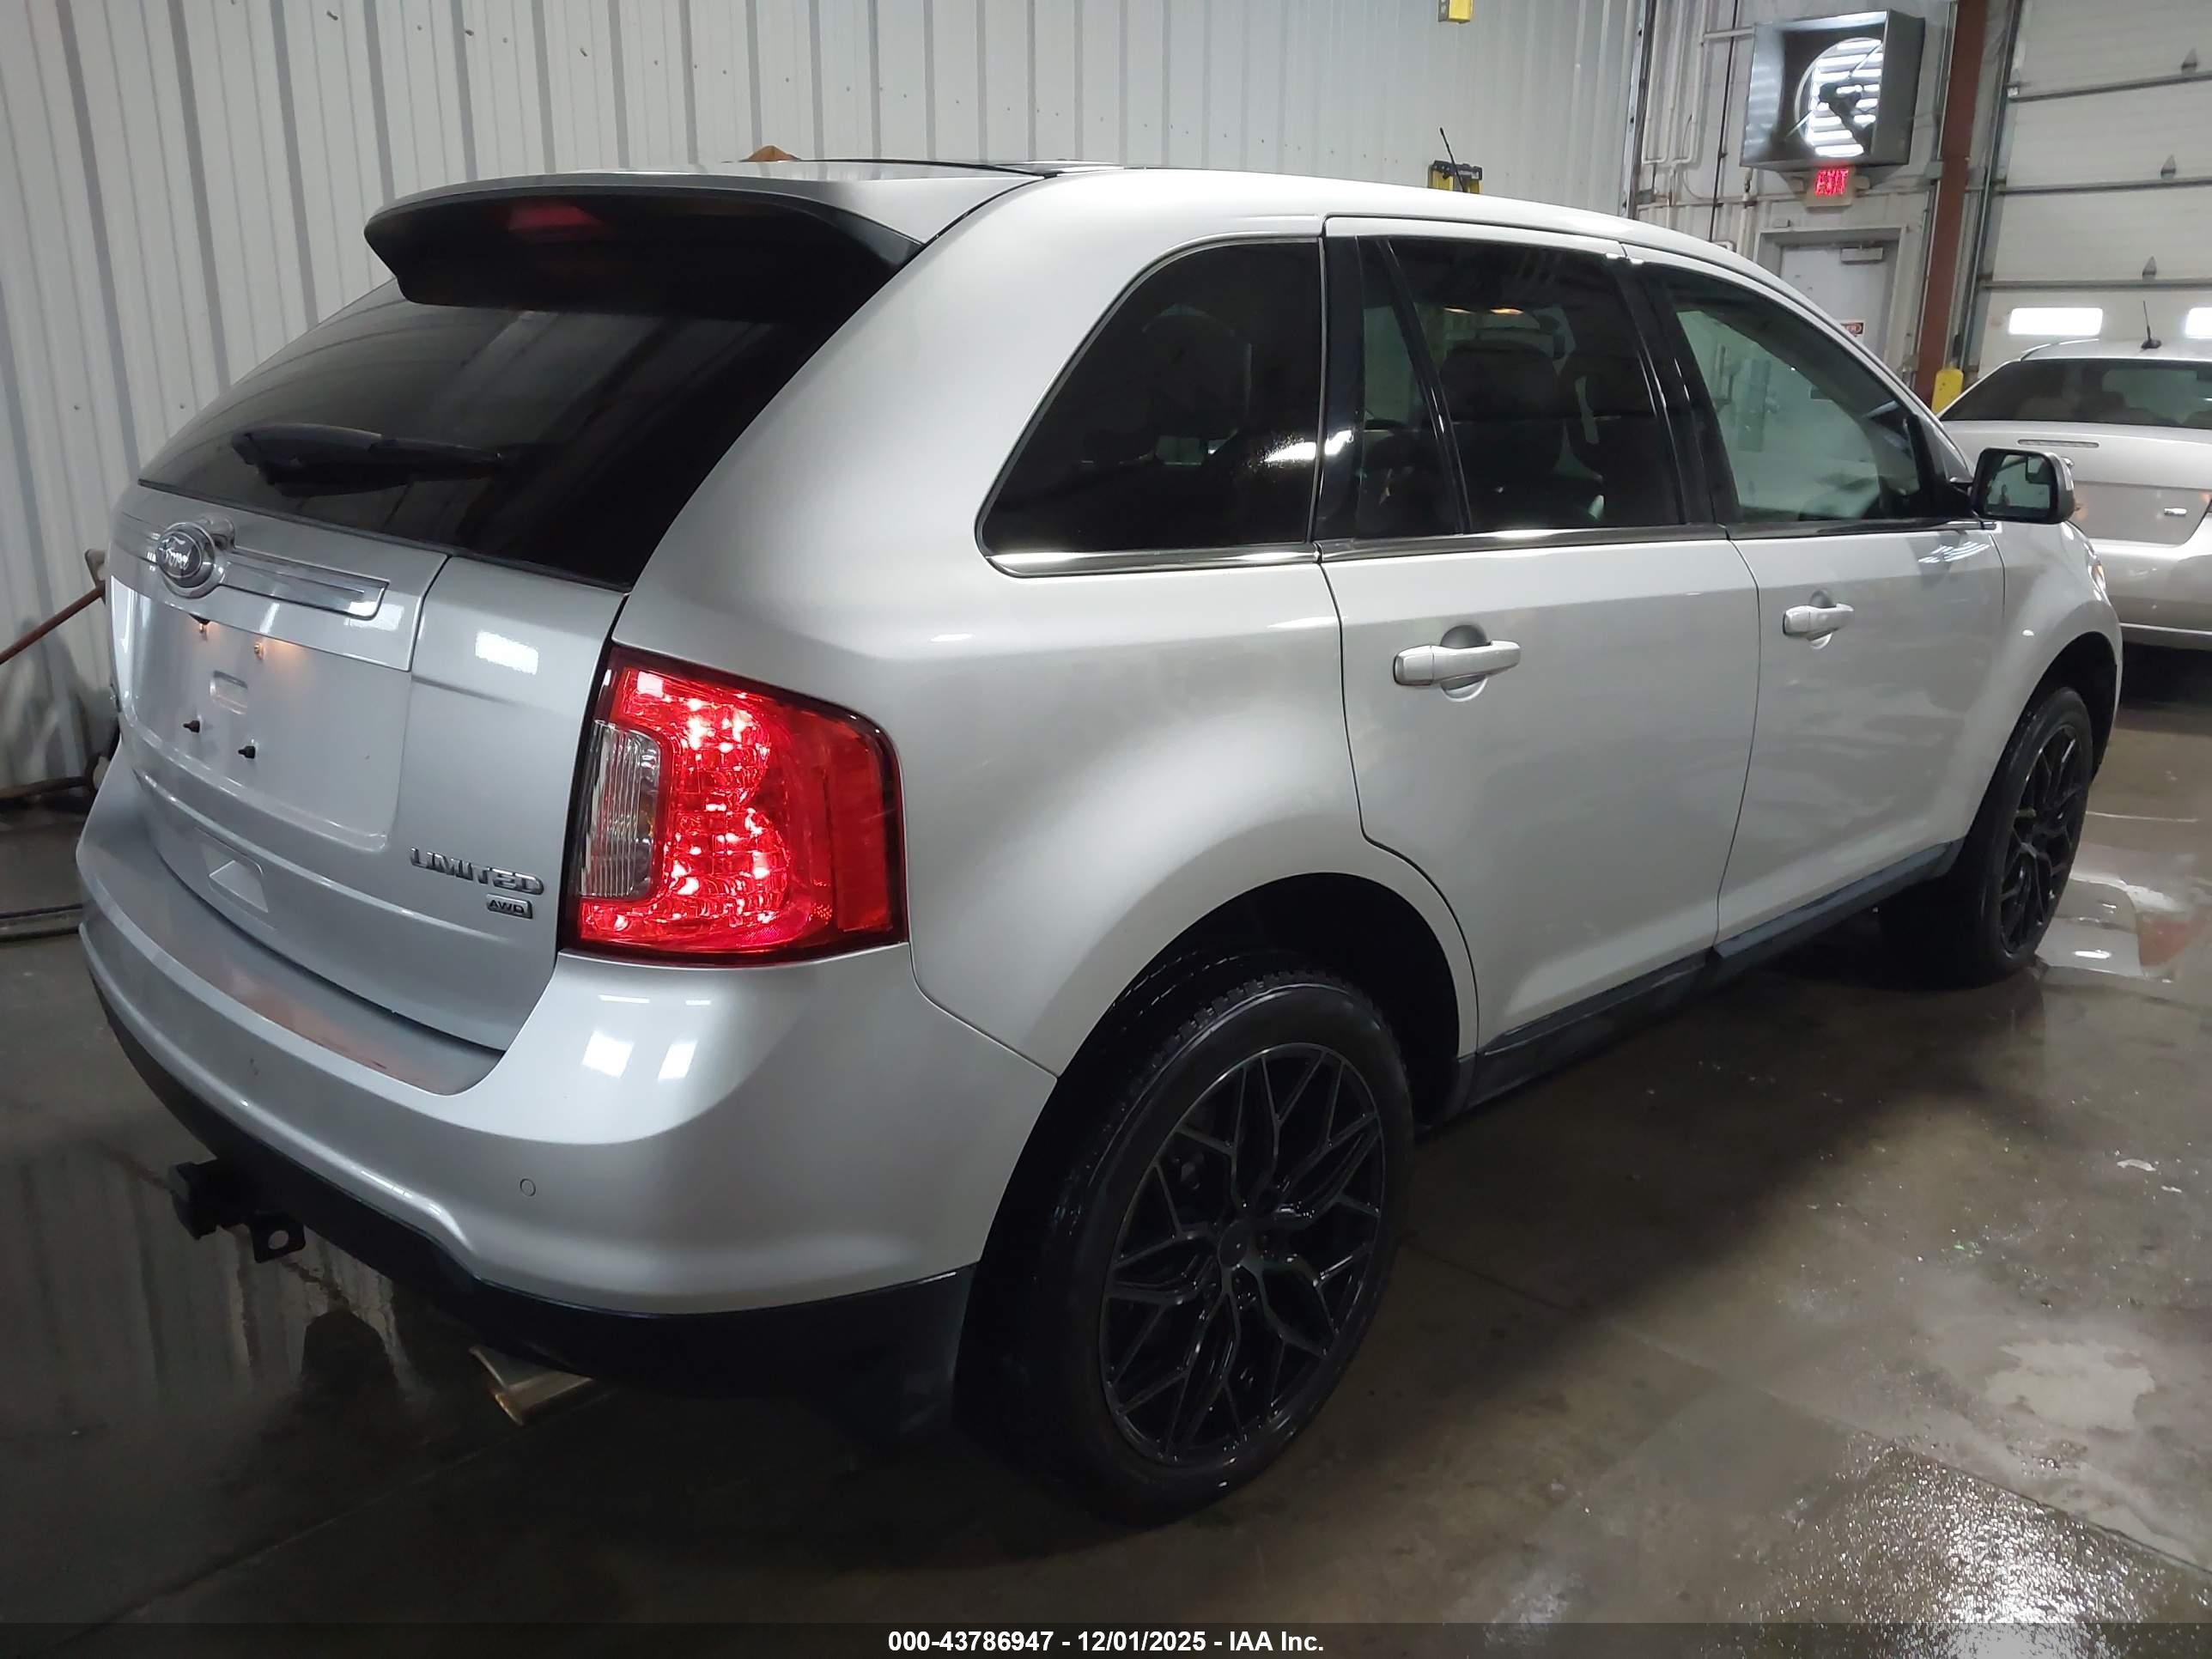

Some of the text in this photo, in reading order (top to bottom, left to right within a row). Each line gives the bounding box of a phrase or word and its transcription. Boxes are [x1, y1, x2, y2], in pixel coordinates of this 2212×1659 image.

[1814, 169, 1849, 195] EXIT
[410, 846, 544, 896] LIMITED
[489, 899, 525, 915] AWD
